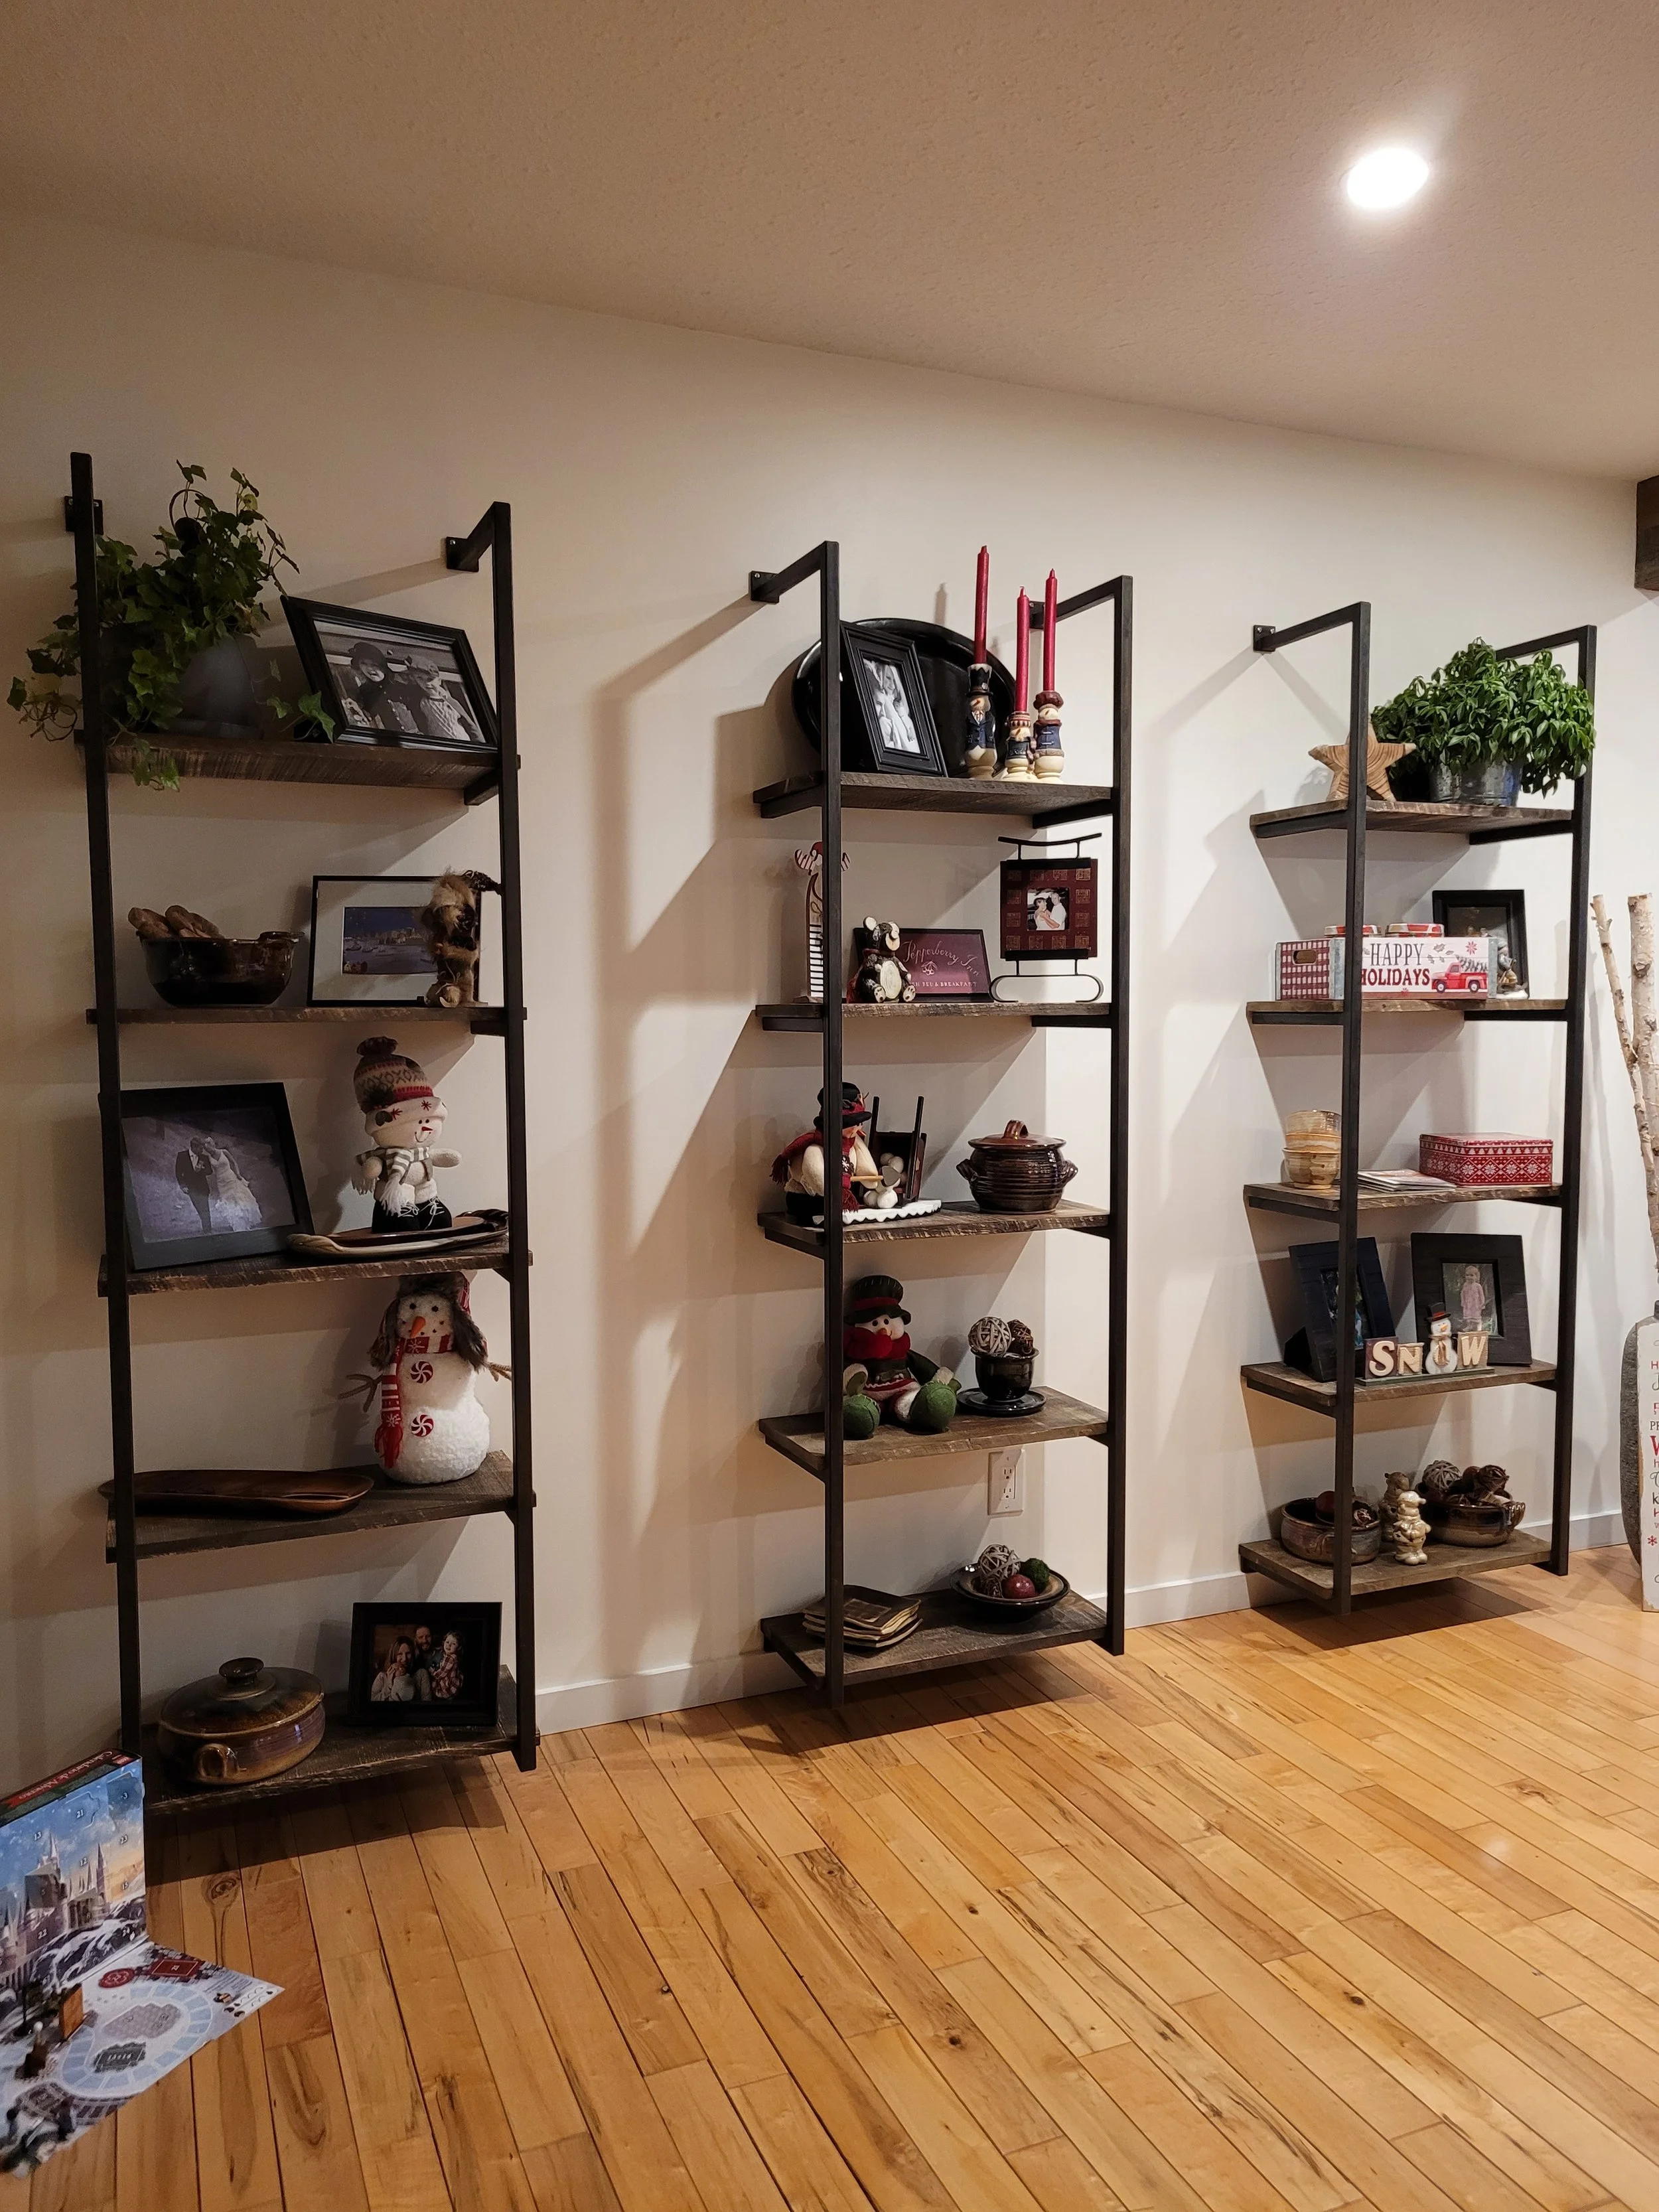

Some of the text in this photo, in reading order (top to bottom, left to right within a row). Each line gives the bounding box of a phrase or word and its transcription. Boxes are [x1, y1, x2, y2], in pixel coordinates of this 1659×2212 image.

[900, 940, 979, 976] Pepperberry Inn
[1370, 942, 1424, 966] HAPPY
[1361, 968, 1430, 986] HOLIDAYS
[1369, 1336, 1486, 1376] SNOW
[76, 1810, 84, 1818] 21
[34, 1832, 42, 1840] 13
[80, 1858, 88, 1866] 12
[122, 1881, 129, 1890] 15
[38, 1929, 47, 1939] 22
